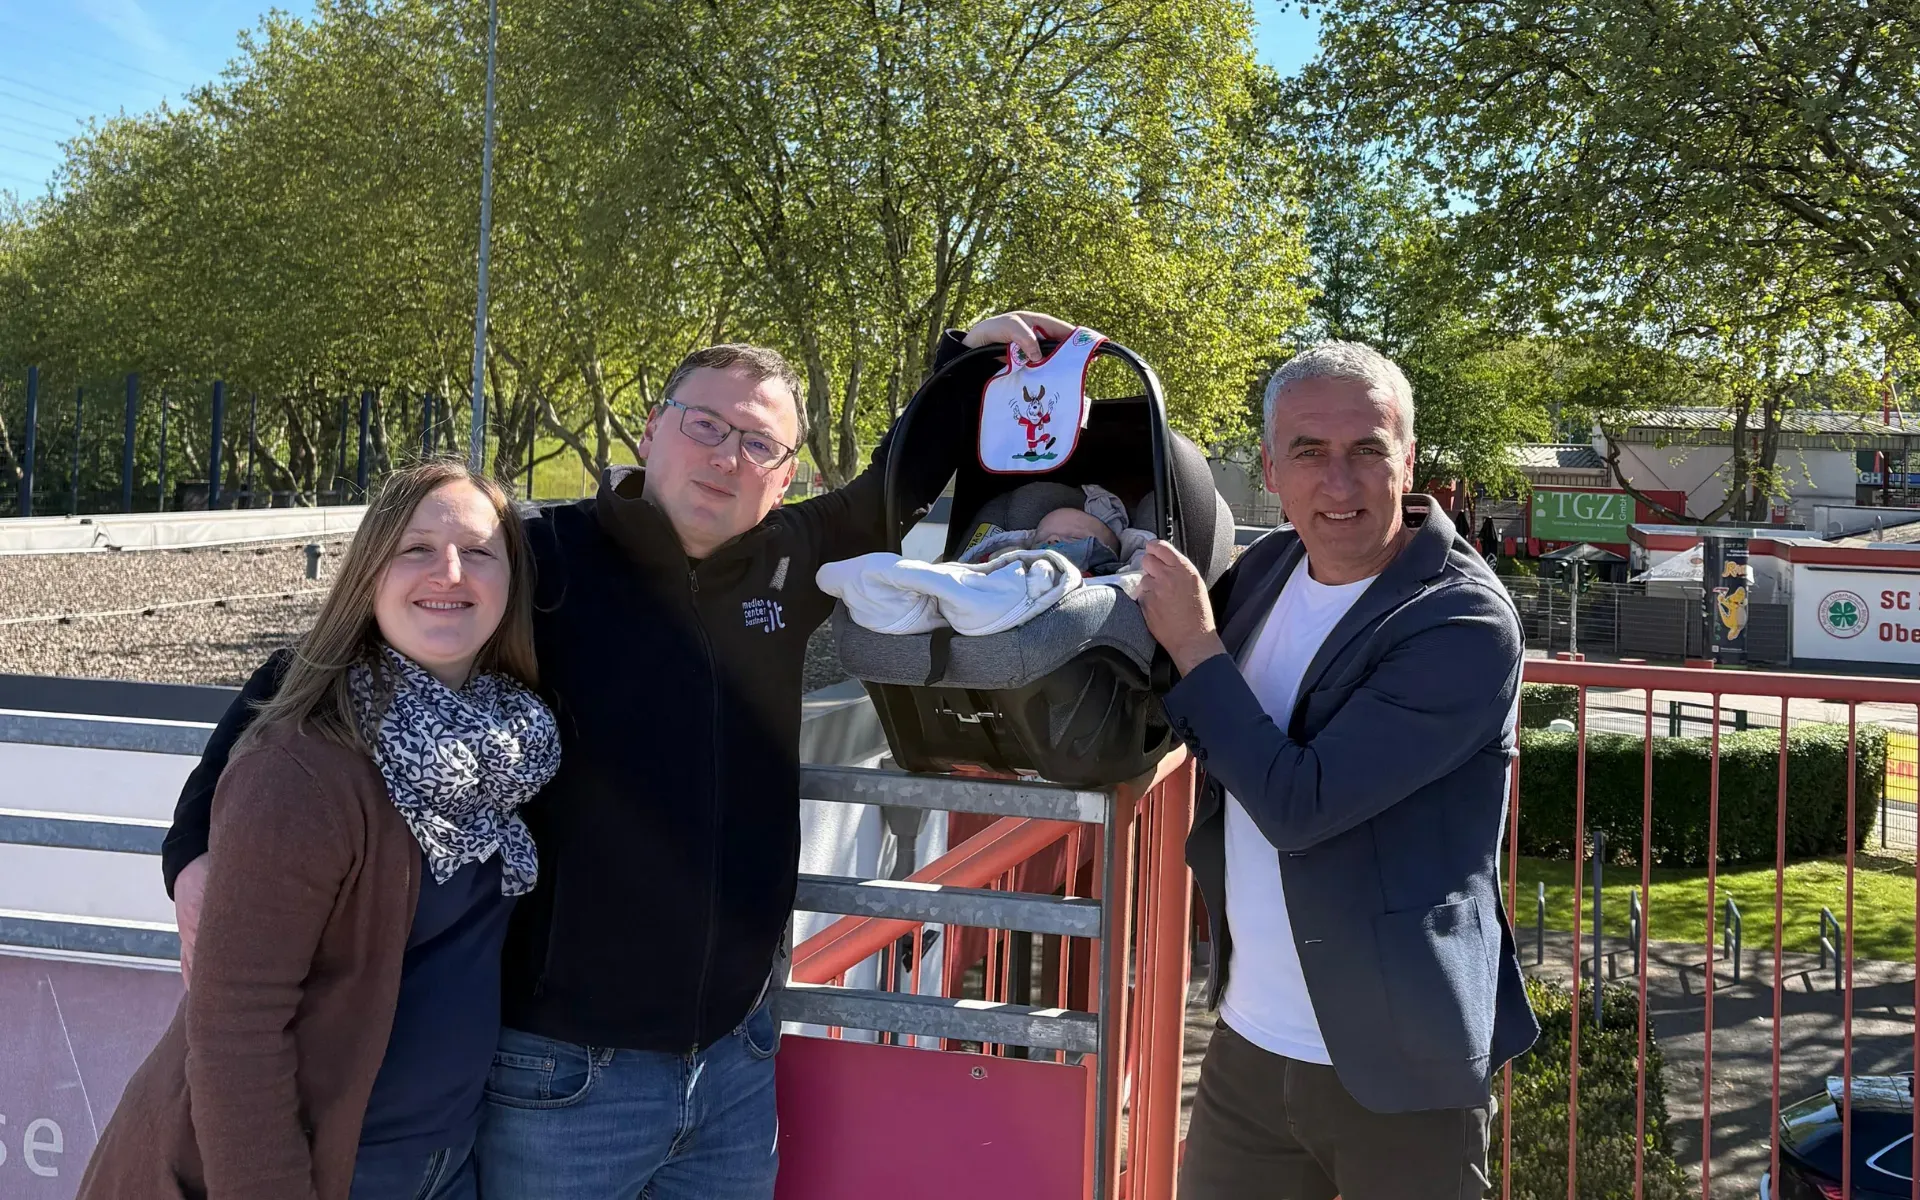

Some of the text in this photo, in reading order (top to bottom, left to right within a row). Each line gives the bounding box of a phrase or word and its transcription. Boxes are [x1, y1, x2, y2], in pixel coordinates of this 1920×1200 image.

[1551, 492, 1632, 521] TGZ GmbH
[1880, 590, 1910, 610] SC
